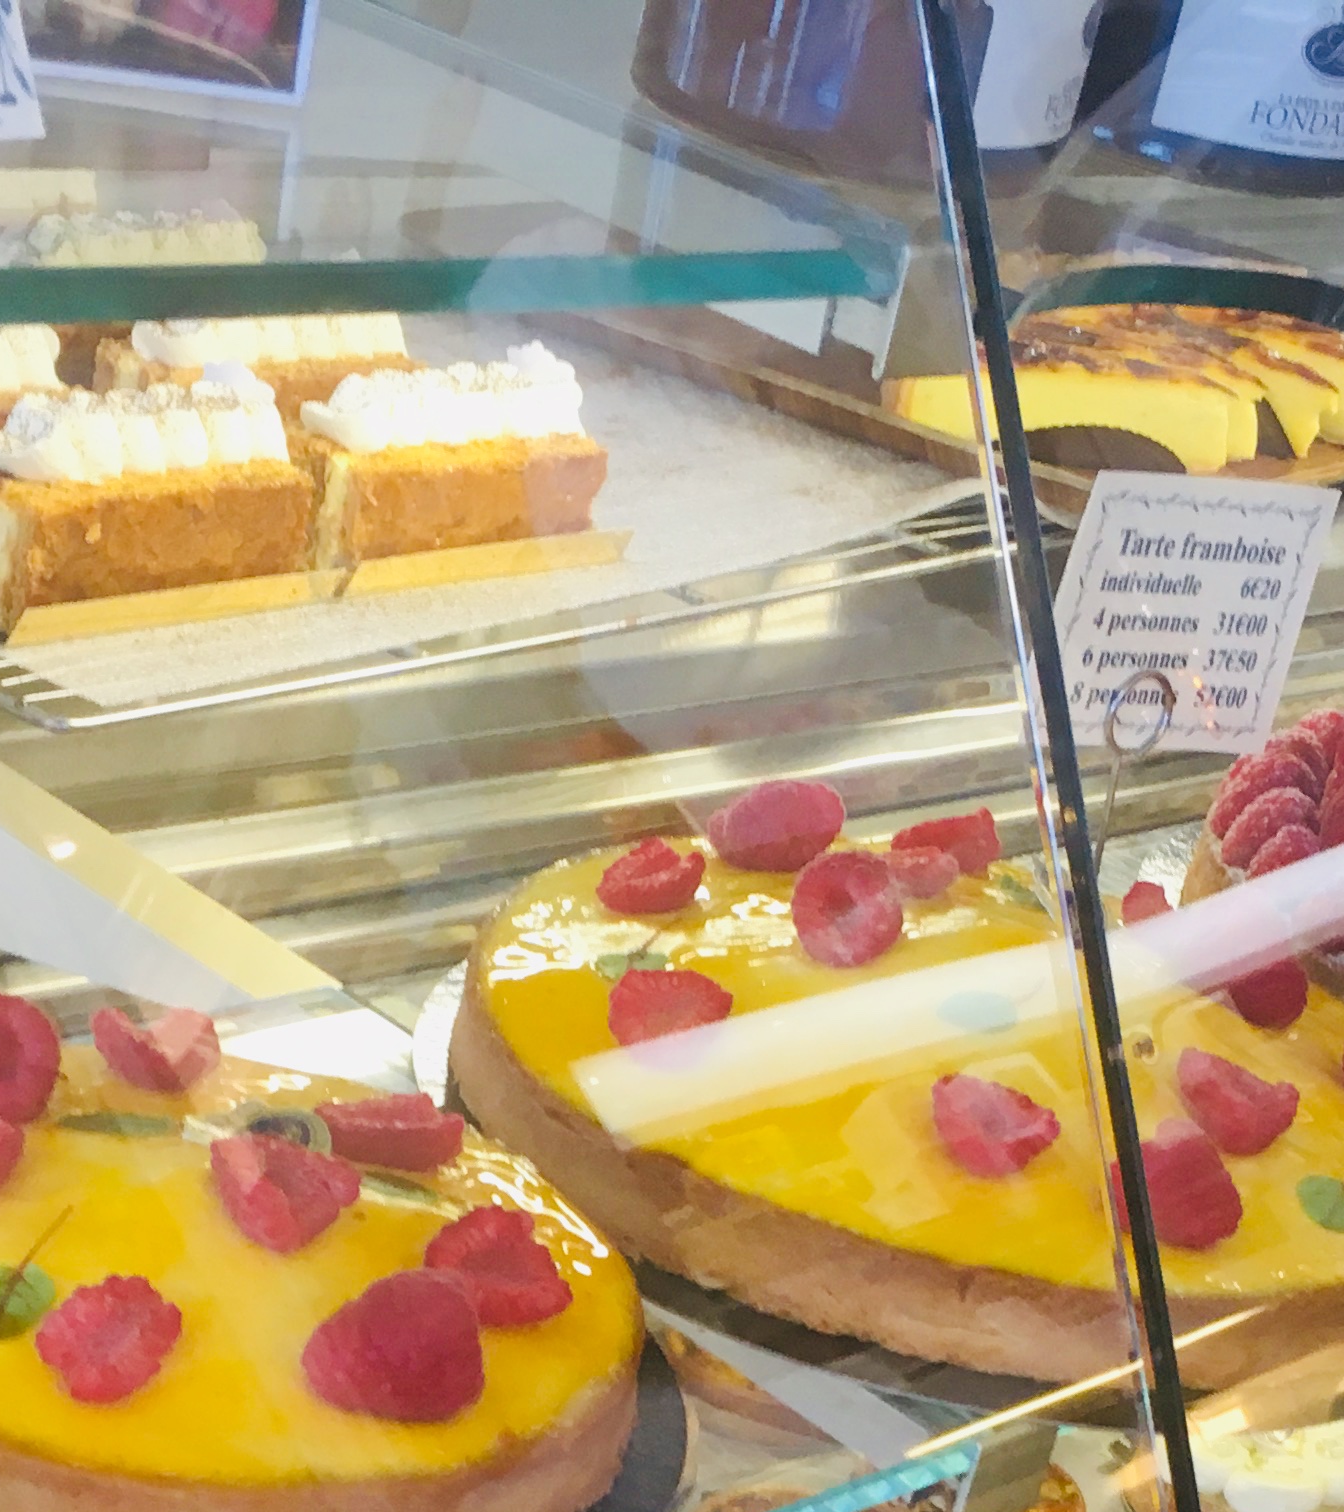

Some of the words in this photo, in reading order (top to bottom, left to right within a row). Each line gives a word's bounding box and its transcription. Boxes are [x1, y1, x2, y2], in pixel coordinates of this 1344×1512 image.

[1119, 528, 1176, 559] Tarte
[1179, 532, 1287, 565] framboise
[1100, 570, 1202, 596] individuelle
[1240, 578, 1281, 600] 6€20
[1093, 608, 1106, 630] 4
[1106, 612, 1199, 637] personnes
[1212, 612, 1268, 637] 31€00
[1082, 647, 1093, 667] 6
[1096, 649, 1188, 673] personnes
[1070, 681, 1084, 704] 8
